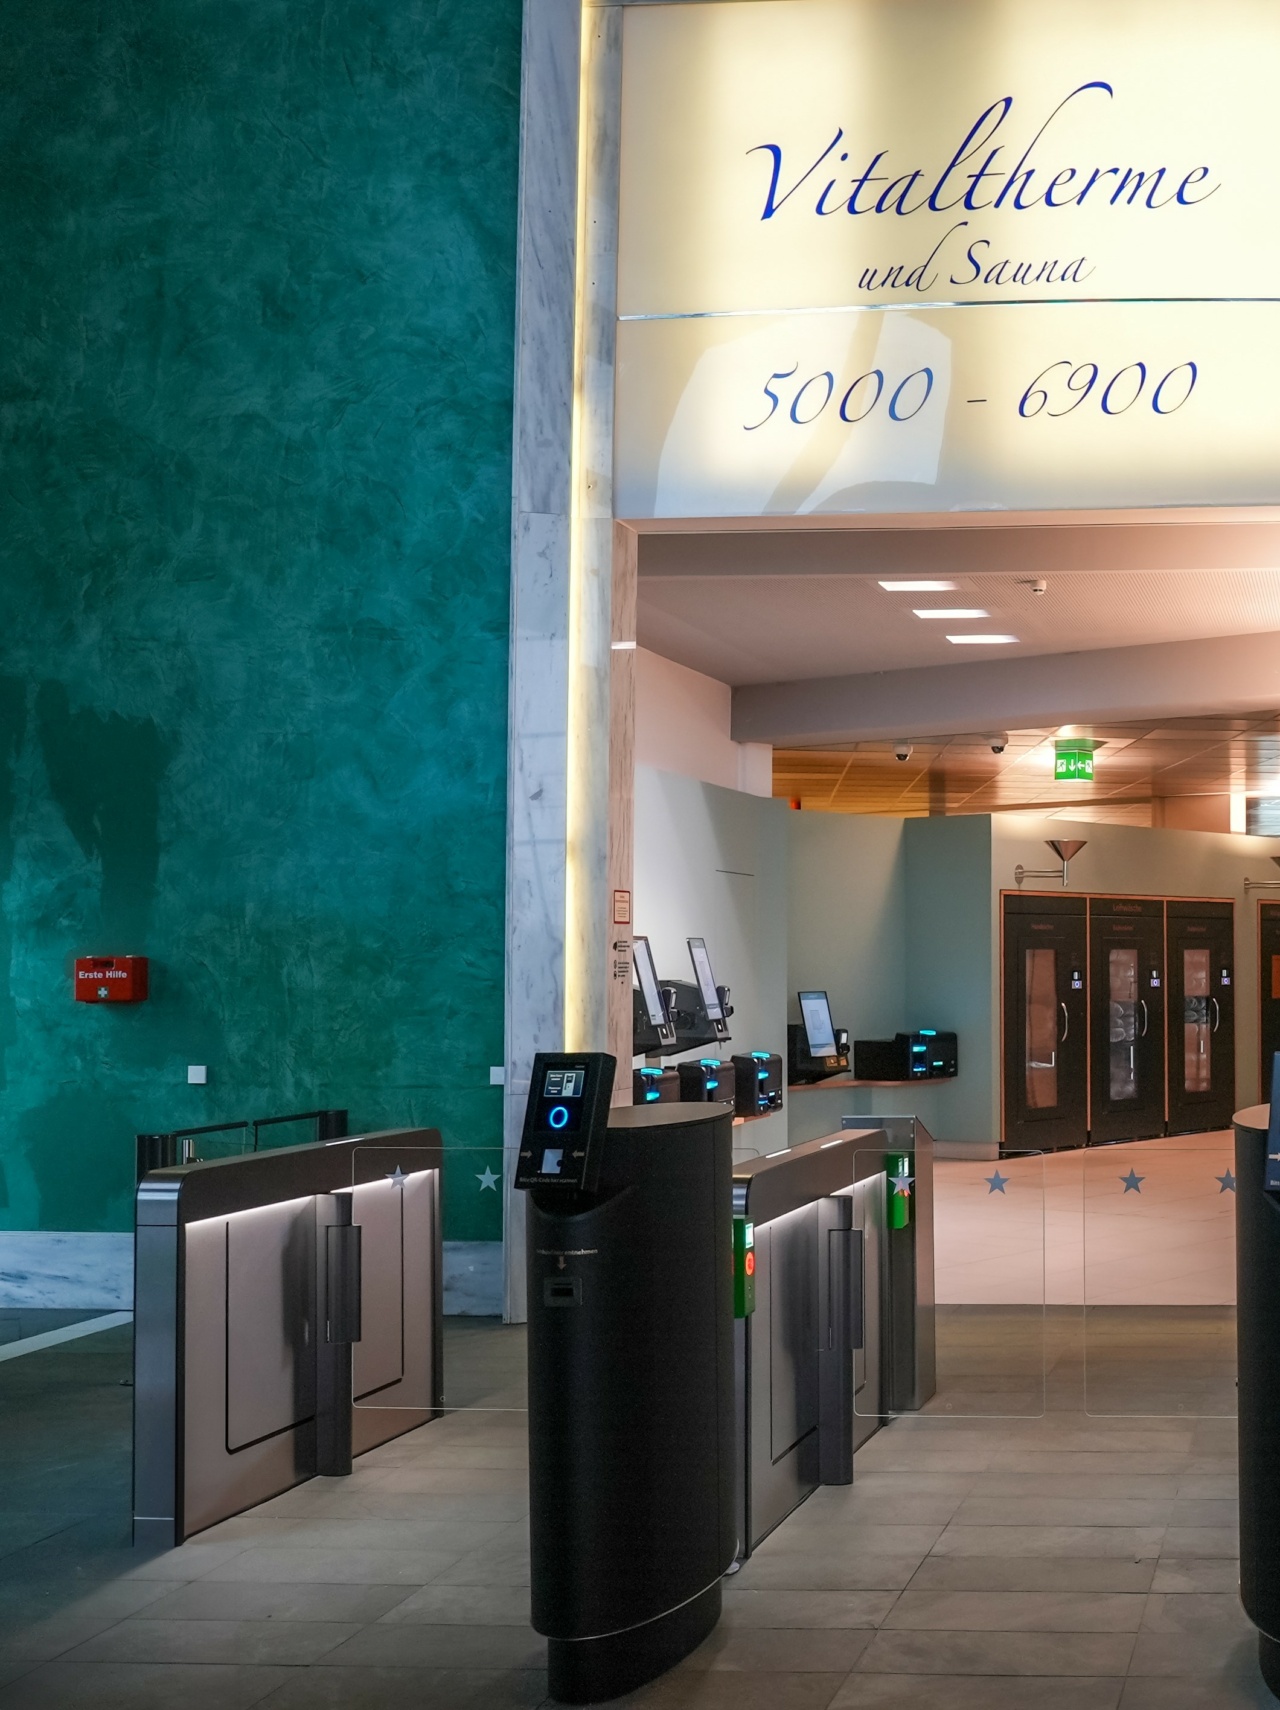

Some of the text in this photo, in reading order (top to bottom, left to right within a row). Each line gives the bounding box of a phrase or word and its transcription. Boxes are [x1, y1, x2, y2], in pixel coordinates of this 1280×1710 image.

[745, 81, 1221, 221] Vitaltherme
[857, 221, 1096, 292] und Sauna
[743, 361, 933, 430] 5000
[1018, 360, 1197, 418] 6900
